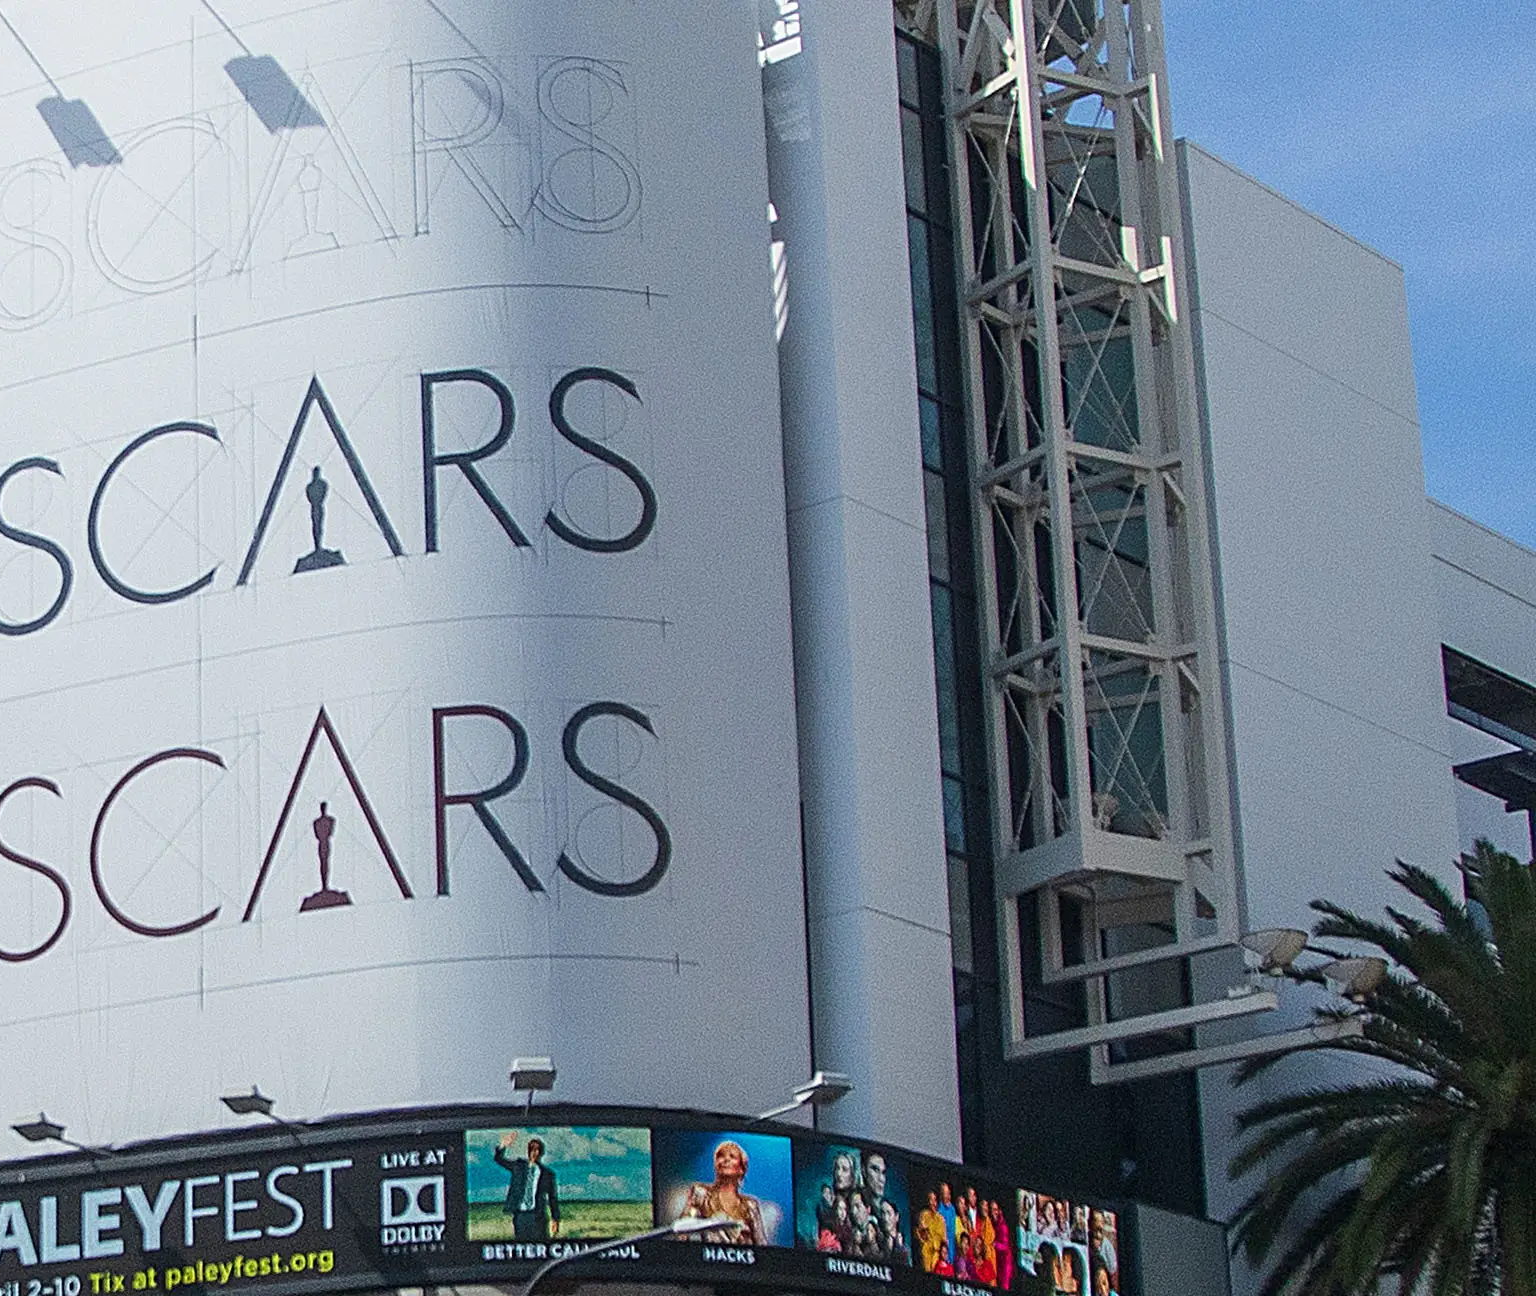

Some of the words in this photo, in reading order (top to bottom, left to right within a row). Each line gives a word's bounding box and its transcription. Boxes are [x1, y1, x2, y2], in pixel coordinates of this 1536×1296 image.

[381, 1151, 418, 1169] LIVE
[422, 1150, 447, 1166] AT
[381, 1224, 446, 1247] DOLBY
[481, 1243, 547, 1260] BETTER
[704, 1247, 756, 1266] HACKS
[90, 1271, 126, 1296] Tix
[133, 1267, 159, 1292] at
[165, 1248, 335, 1294] paleyfest.org
[827, 1256, 893, 1283] RIVERDALE
